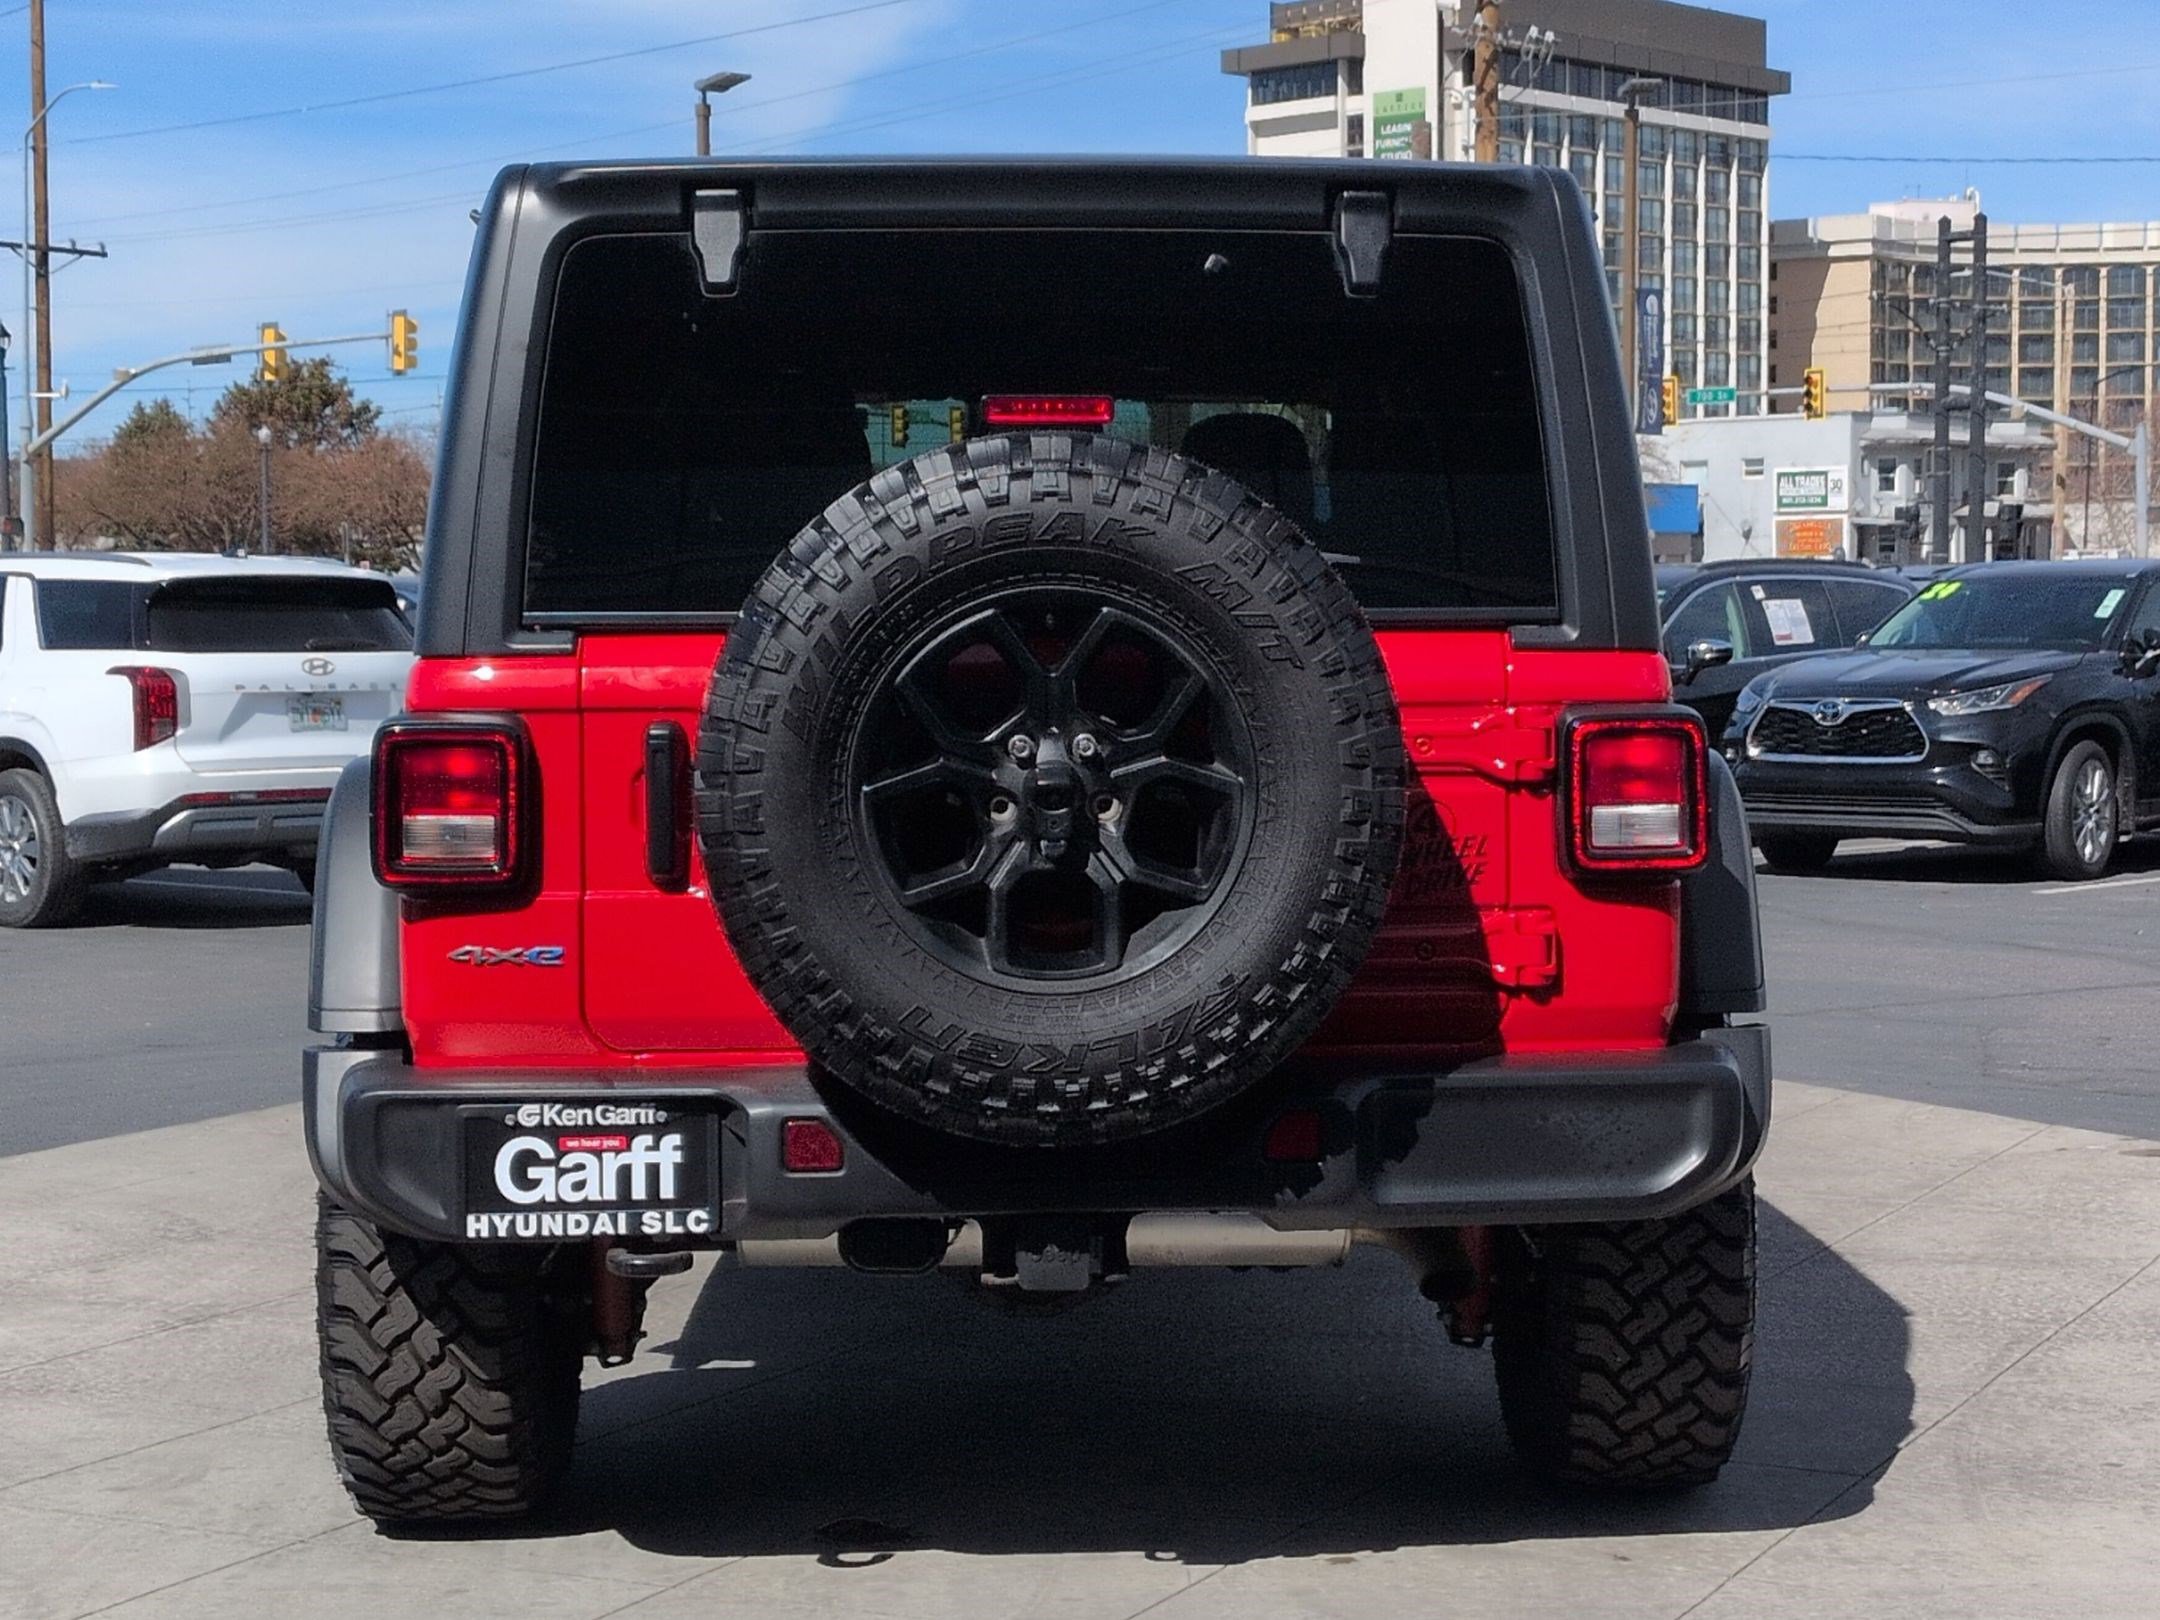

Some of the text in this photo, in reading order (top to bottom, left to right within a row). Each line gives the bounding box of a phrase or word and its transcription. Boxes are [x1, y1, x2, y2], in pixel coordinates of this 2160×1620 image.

[494, 1133, 683, 1204] Garff
[466, 1209, 710, 1238] HYUNDAI SLC
